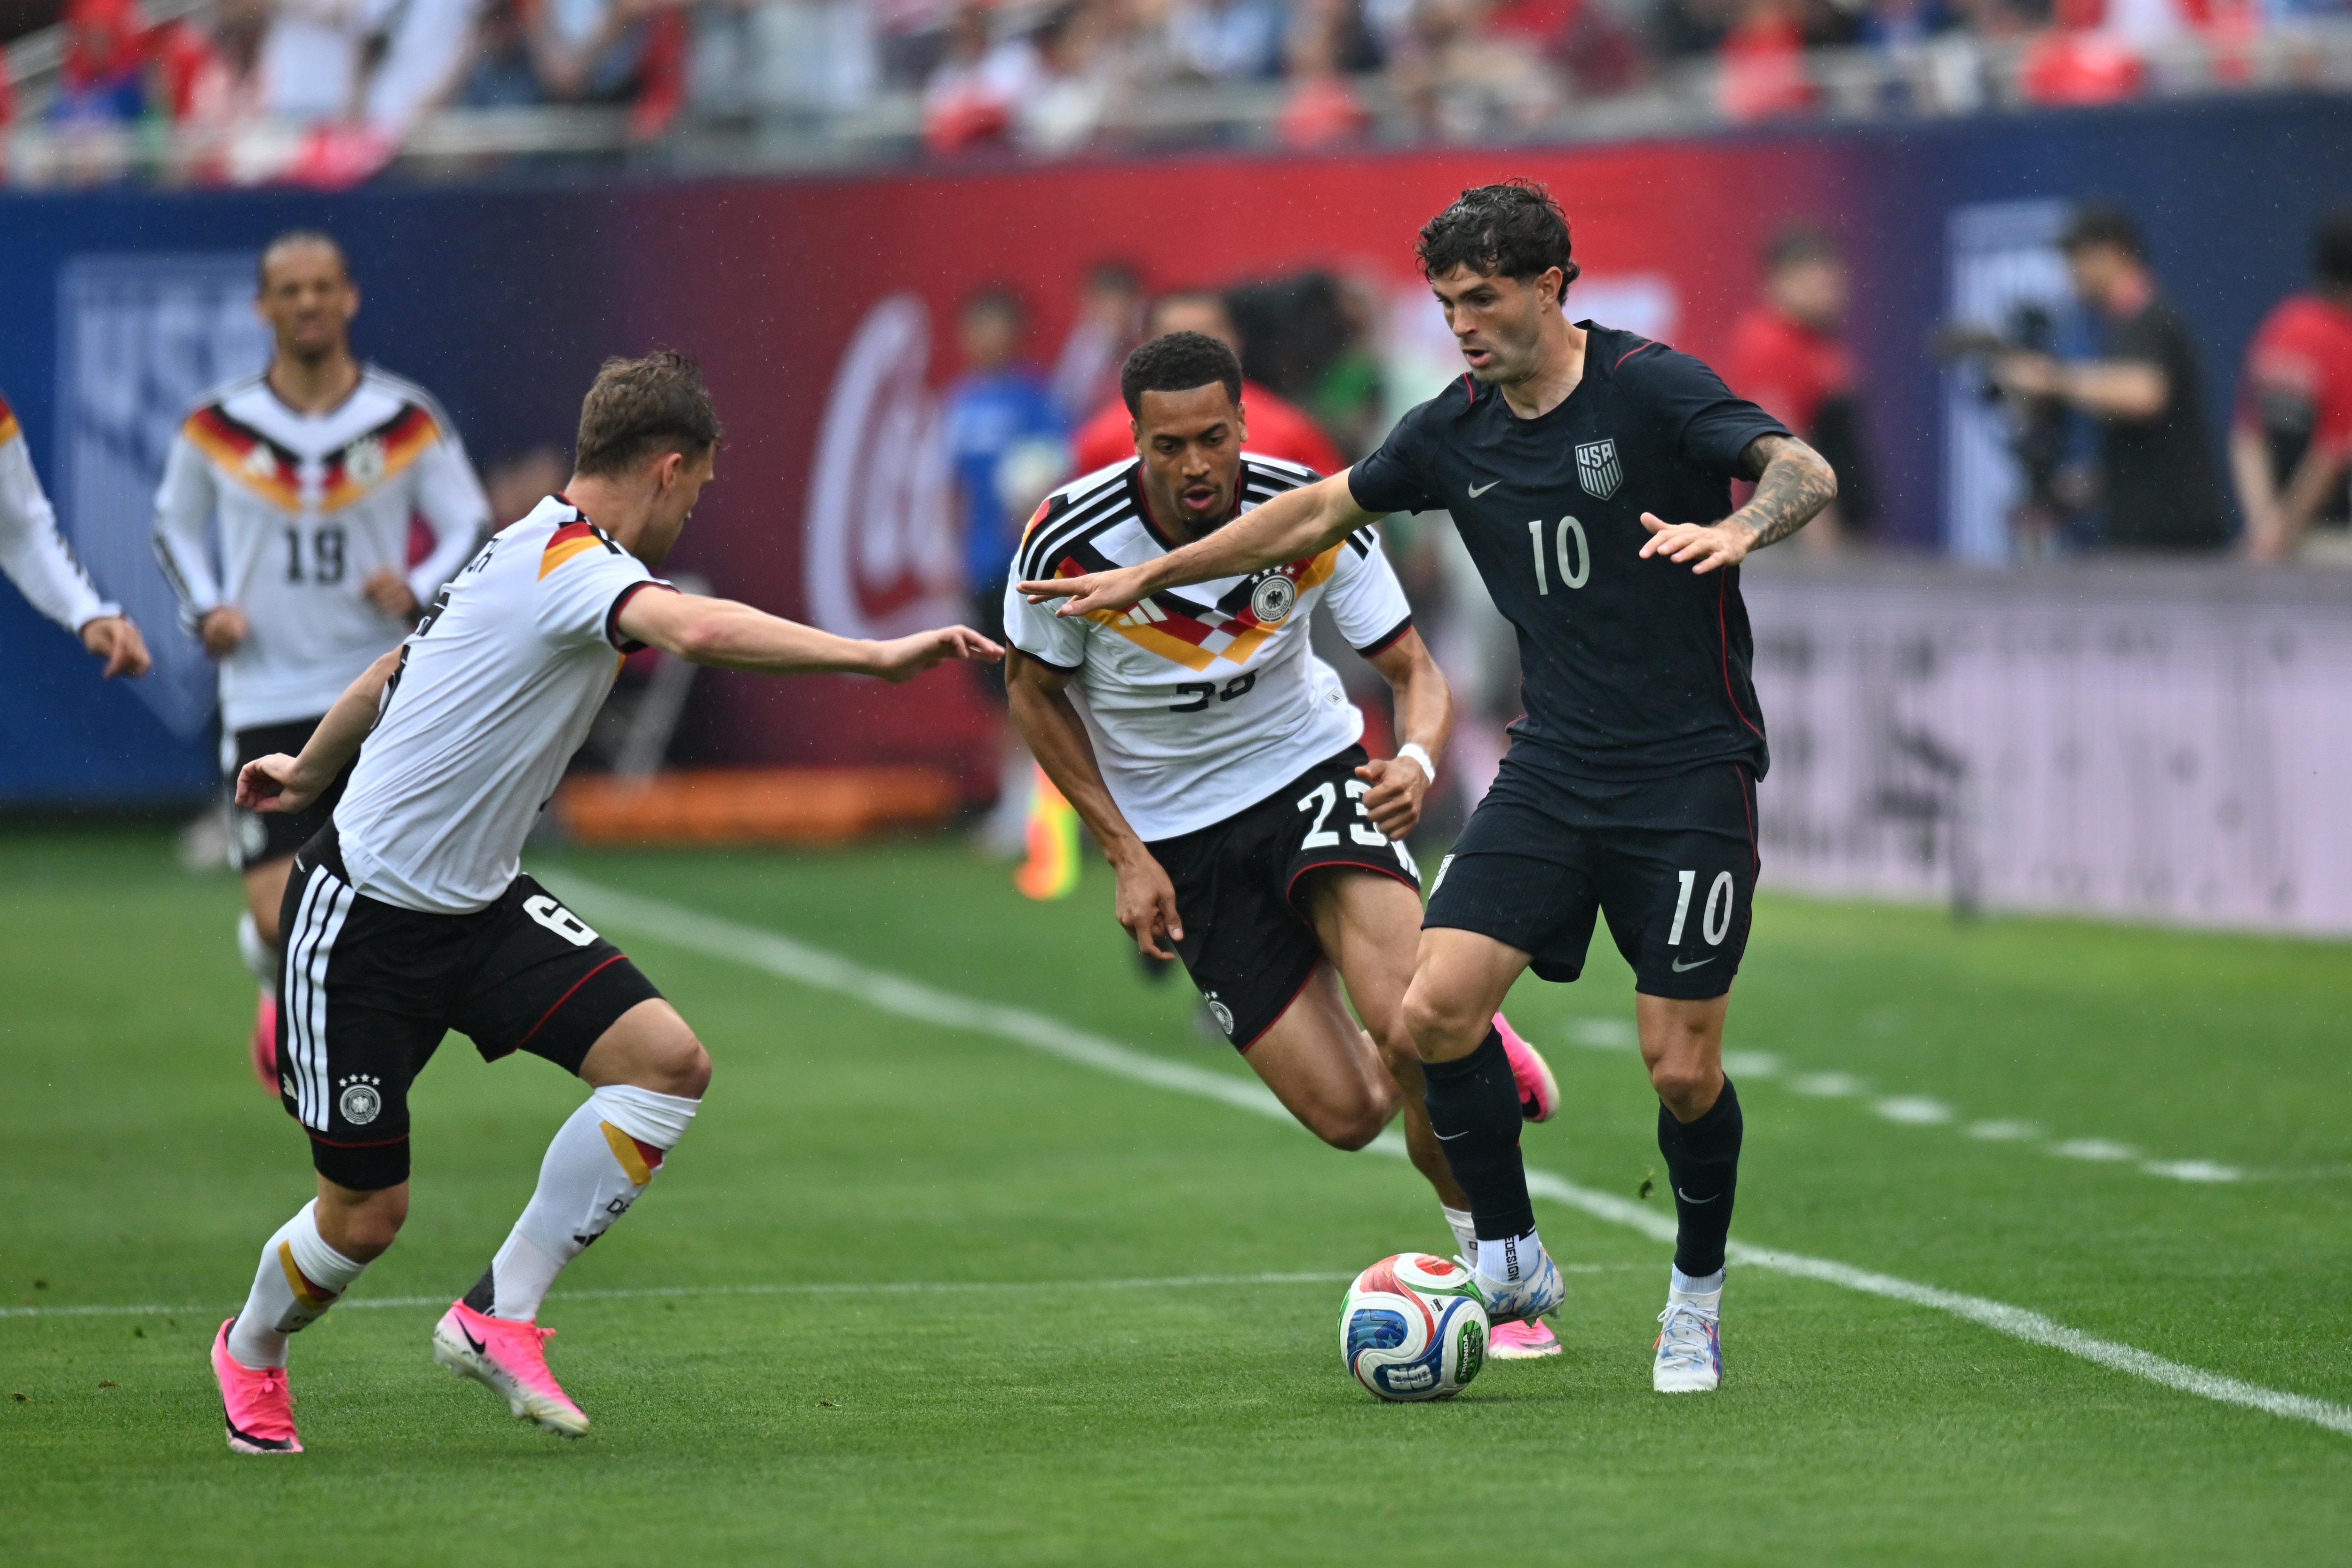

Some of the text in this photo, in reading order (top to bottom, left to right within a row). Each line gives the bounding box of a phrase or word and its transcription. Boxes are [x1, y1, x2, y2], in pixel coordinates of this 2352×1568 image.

[1578, 443, 1613, 468] USA
[285, 525, 347, 585] 19
[1528, 515, 1590, 596] 10
[1297, 779, 1388, 850] 23
[523, 895, 600, 946] 6
[1668, 870, 1734, 946] 10
[1459, 1334, 1469, 1378] TRIONDA
